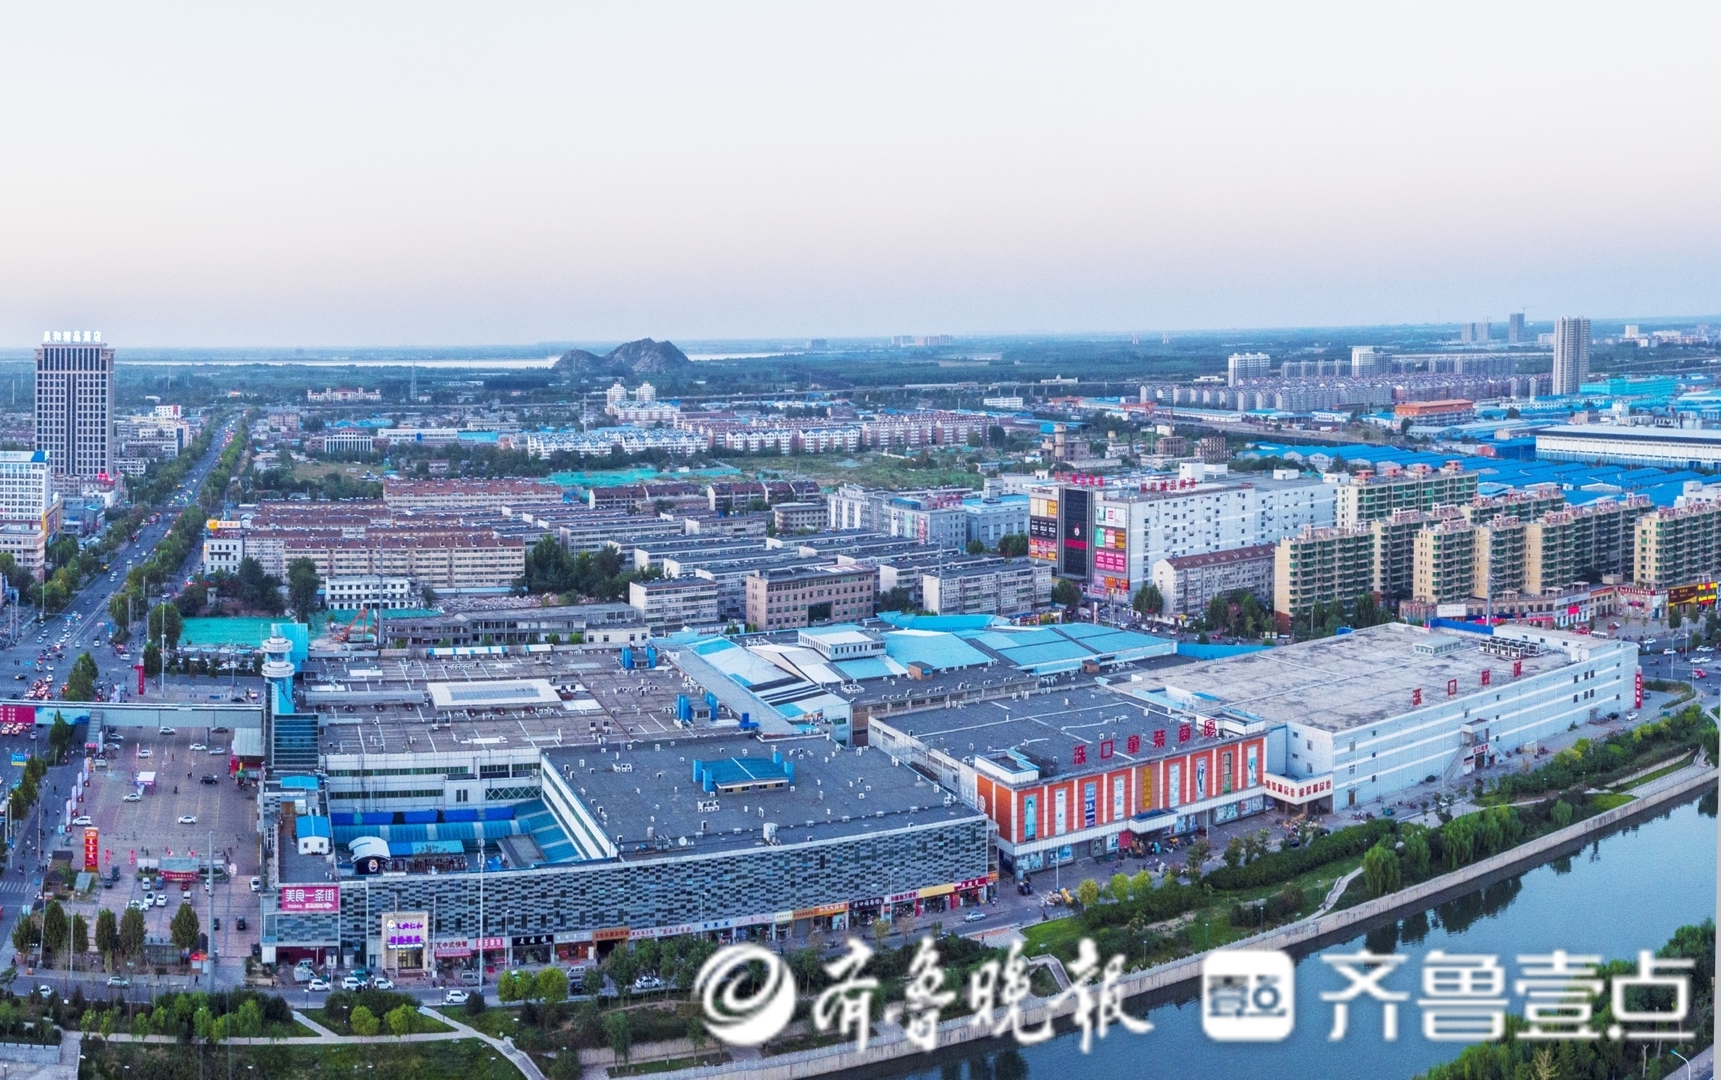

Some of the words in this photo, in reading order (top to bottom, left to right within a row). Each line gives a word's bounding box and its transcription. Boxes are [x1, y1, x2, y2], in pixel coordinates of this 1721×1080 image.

[1073, 718, 1216, 765] 泺口童装商厦
[285, 889, 335, 902] 美食一条街
